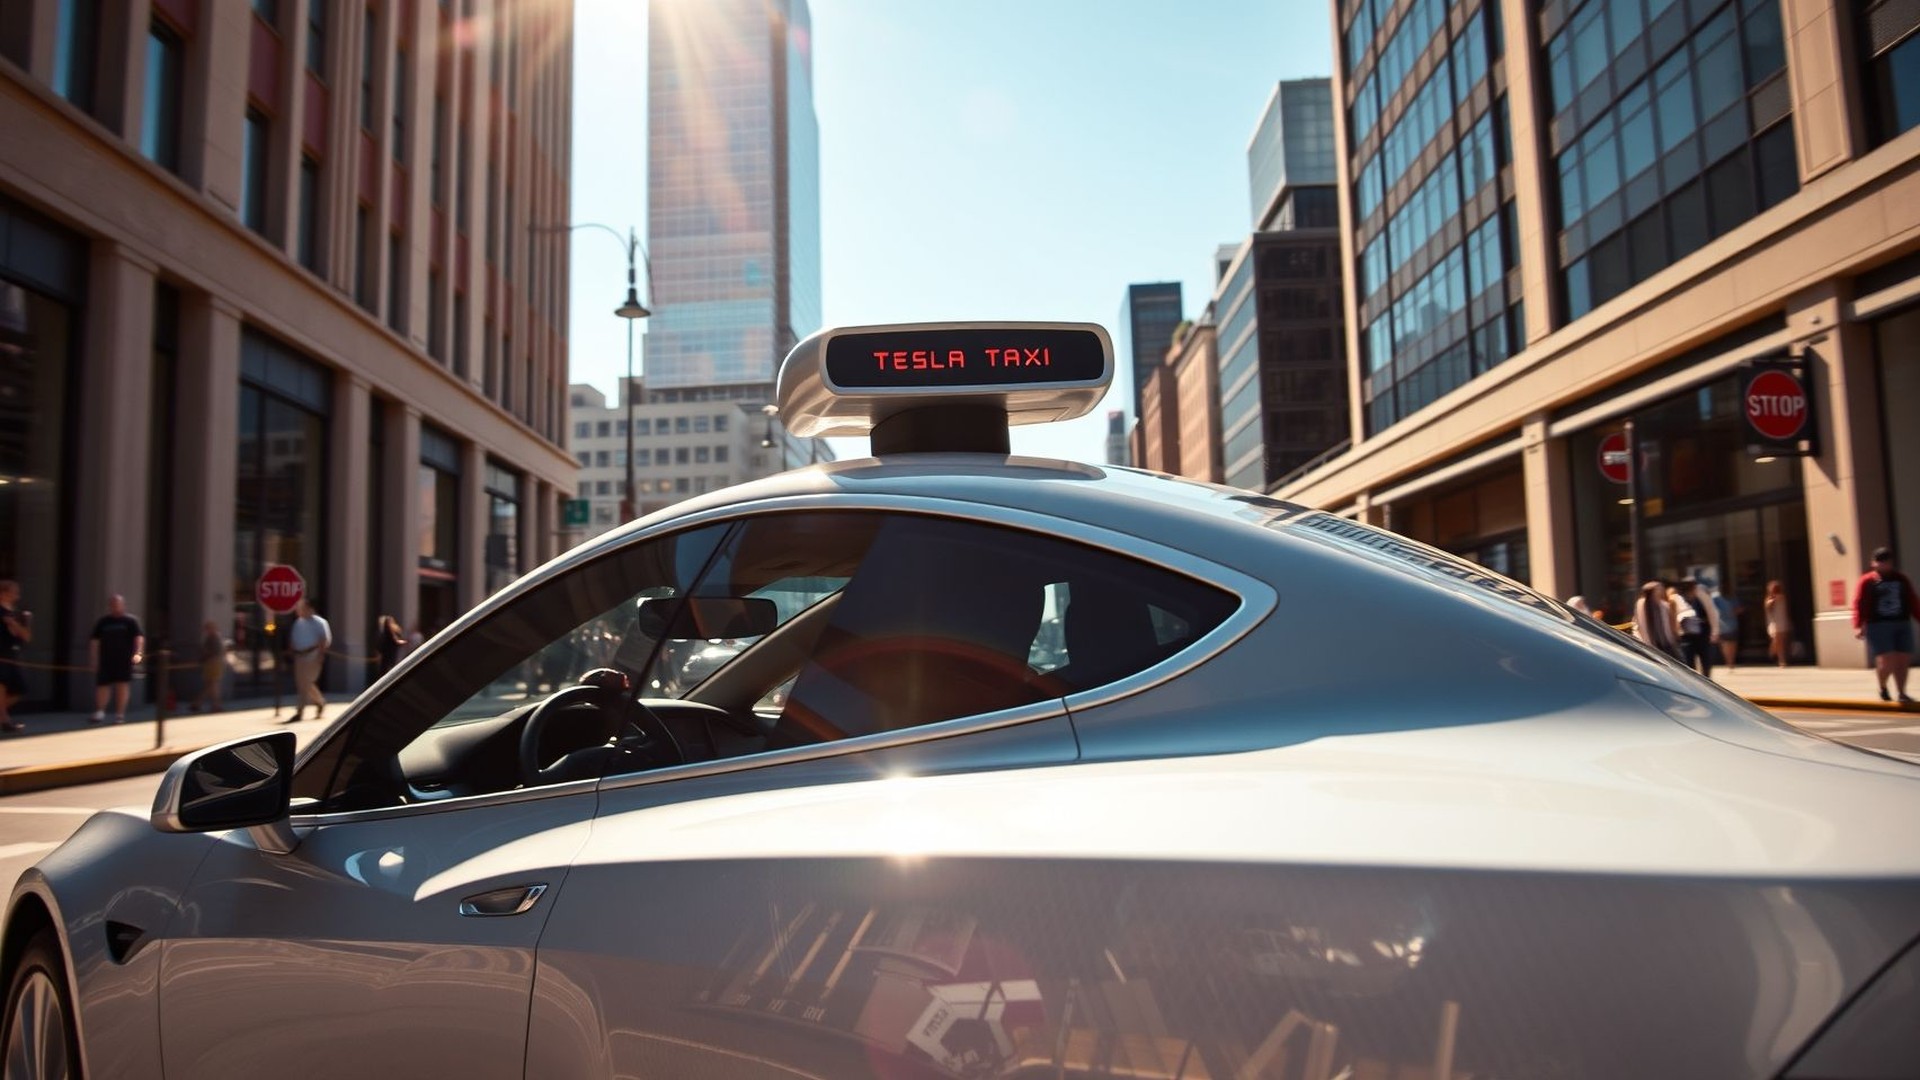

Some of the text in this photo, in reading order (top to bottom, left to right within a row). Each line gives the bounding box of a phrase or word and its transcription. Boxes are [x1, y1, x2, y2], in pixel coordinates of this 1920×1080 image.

[873, 348, 1050, 370] TESLA TAXI
[261, 582, 303, 598] STOP
